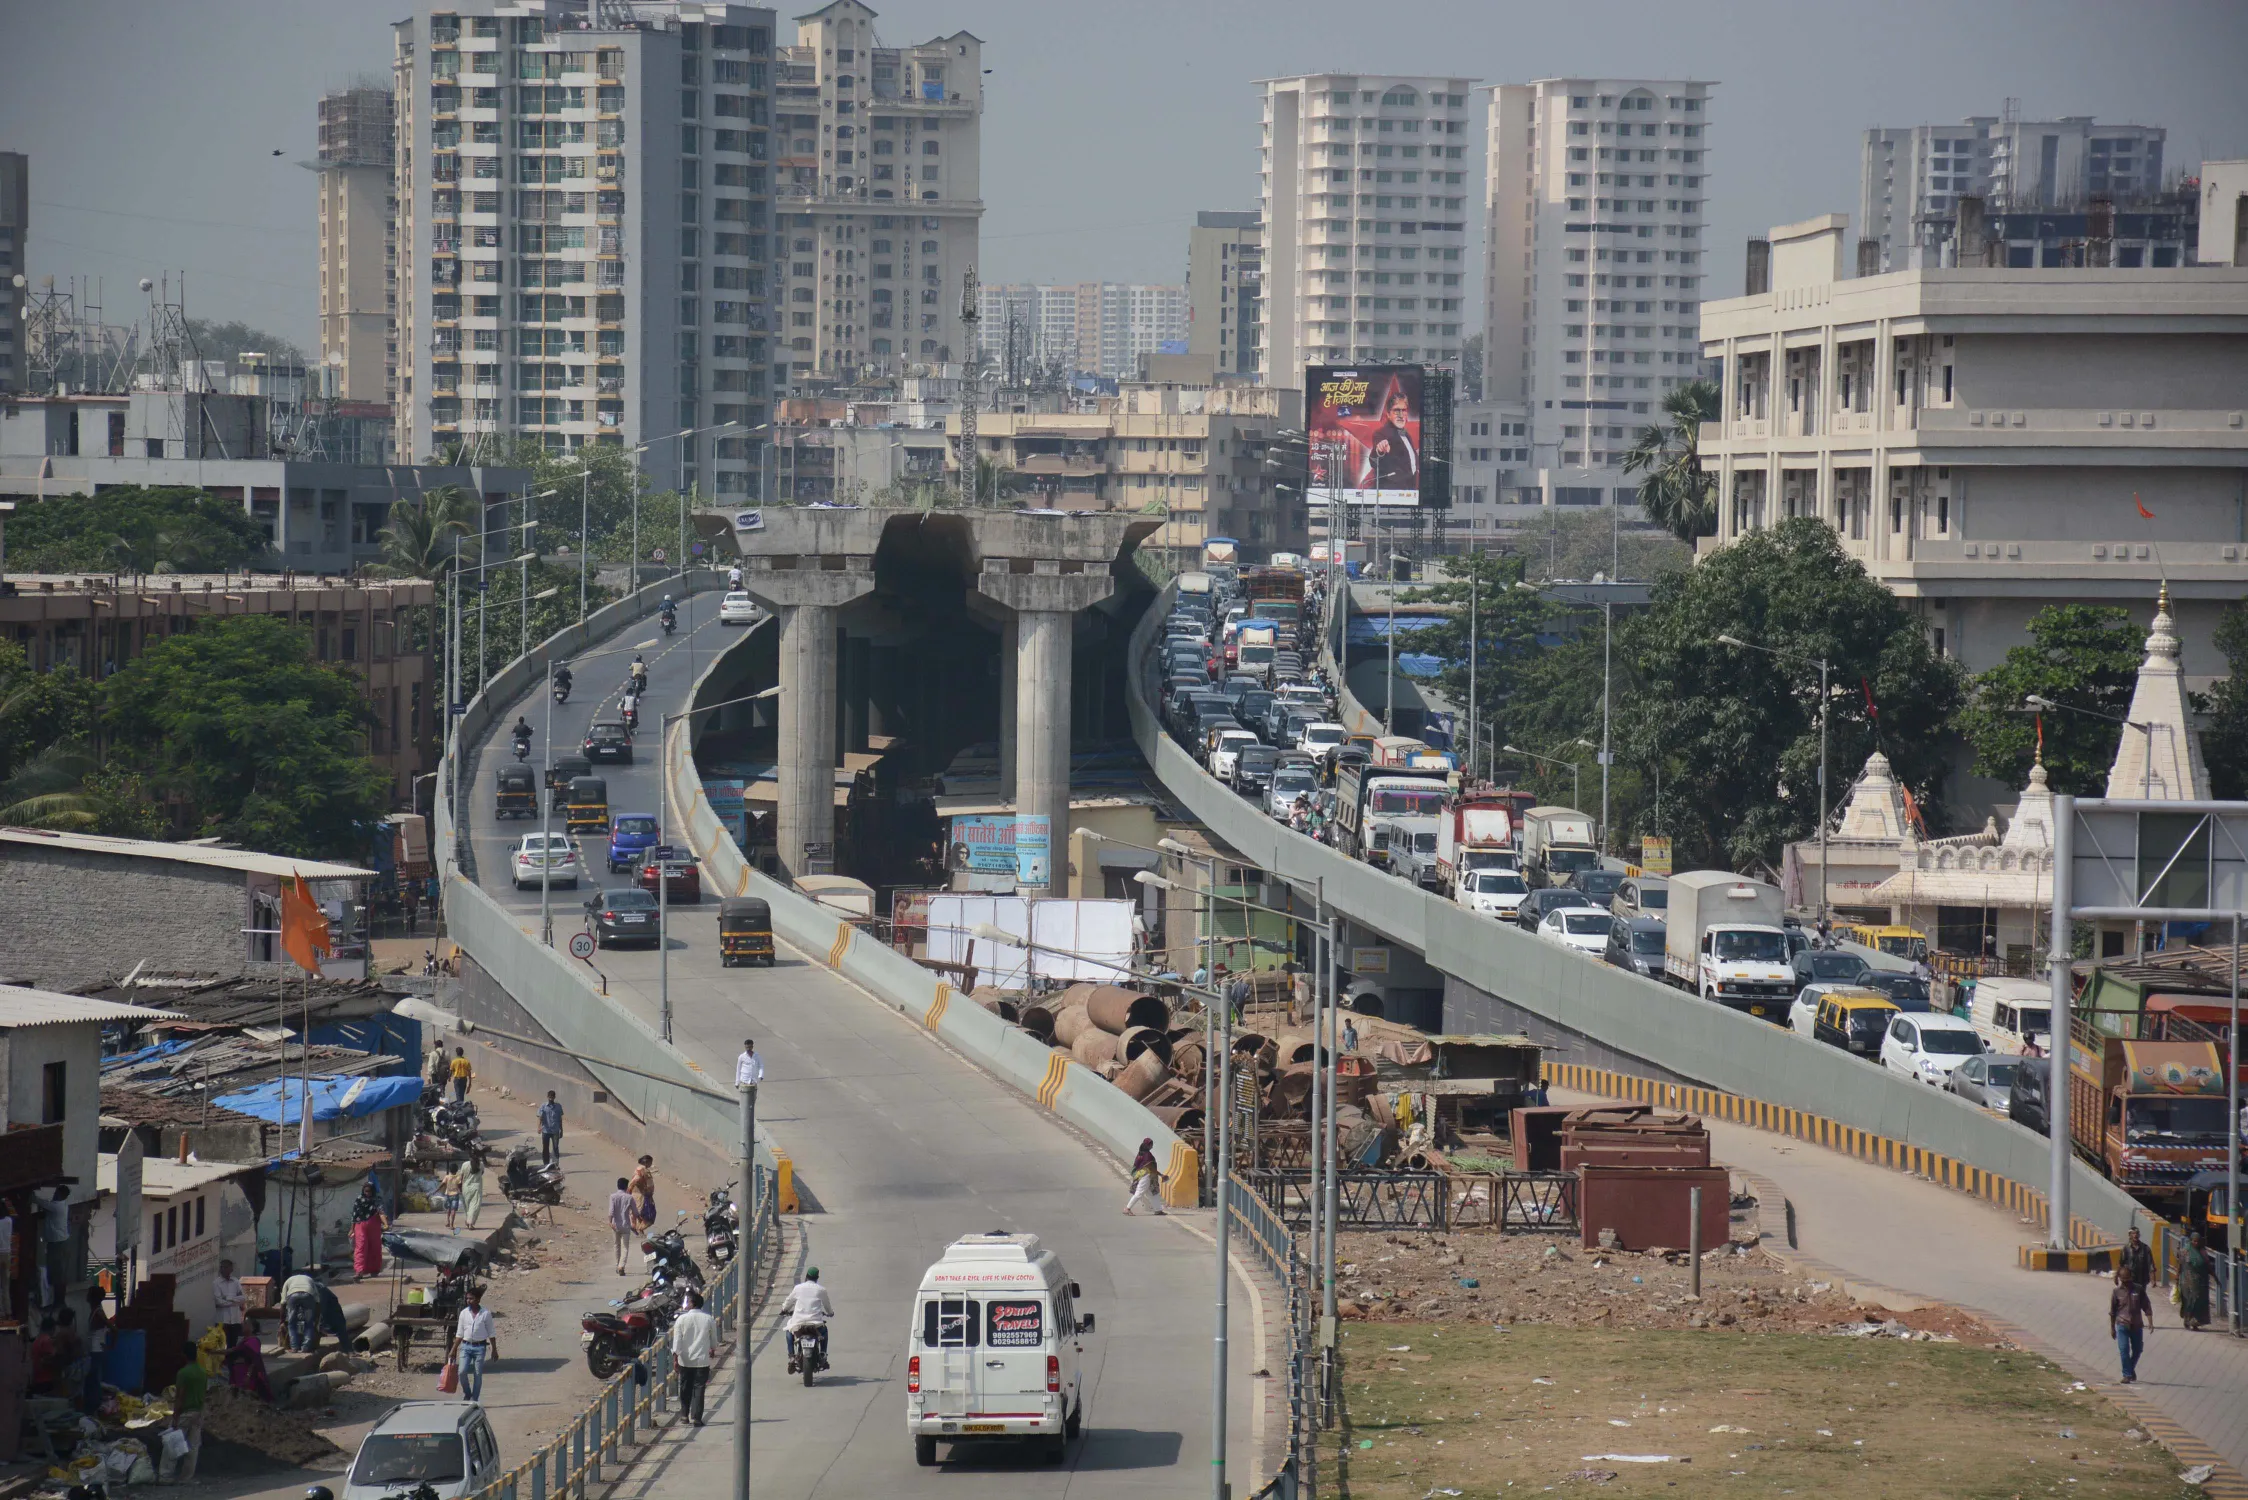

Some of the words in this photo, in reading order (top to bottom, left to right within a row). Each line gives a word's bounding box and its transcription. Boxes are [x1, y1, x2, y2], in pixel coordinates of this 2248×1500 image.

[1320, 382, 1339, 392] आज
[1355, 382, 1369, 392] रात
[1324, 393, 1332, 408] है
[576, 941, 590, 952] 30
[996, 1318, 1040, 1331] TRAVELS
